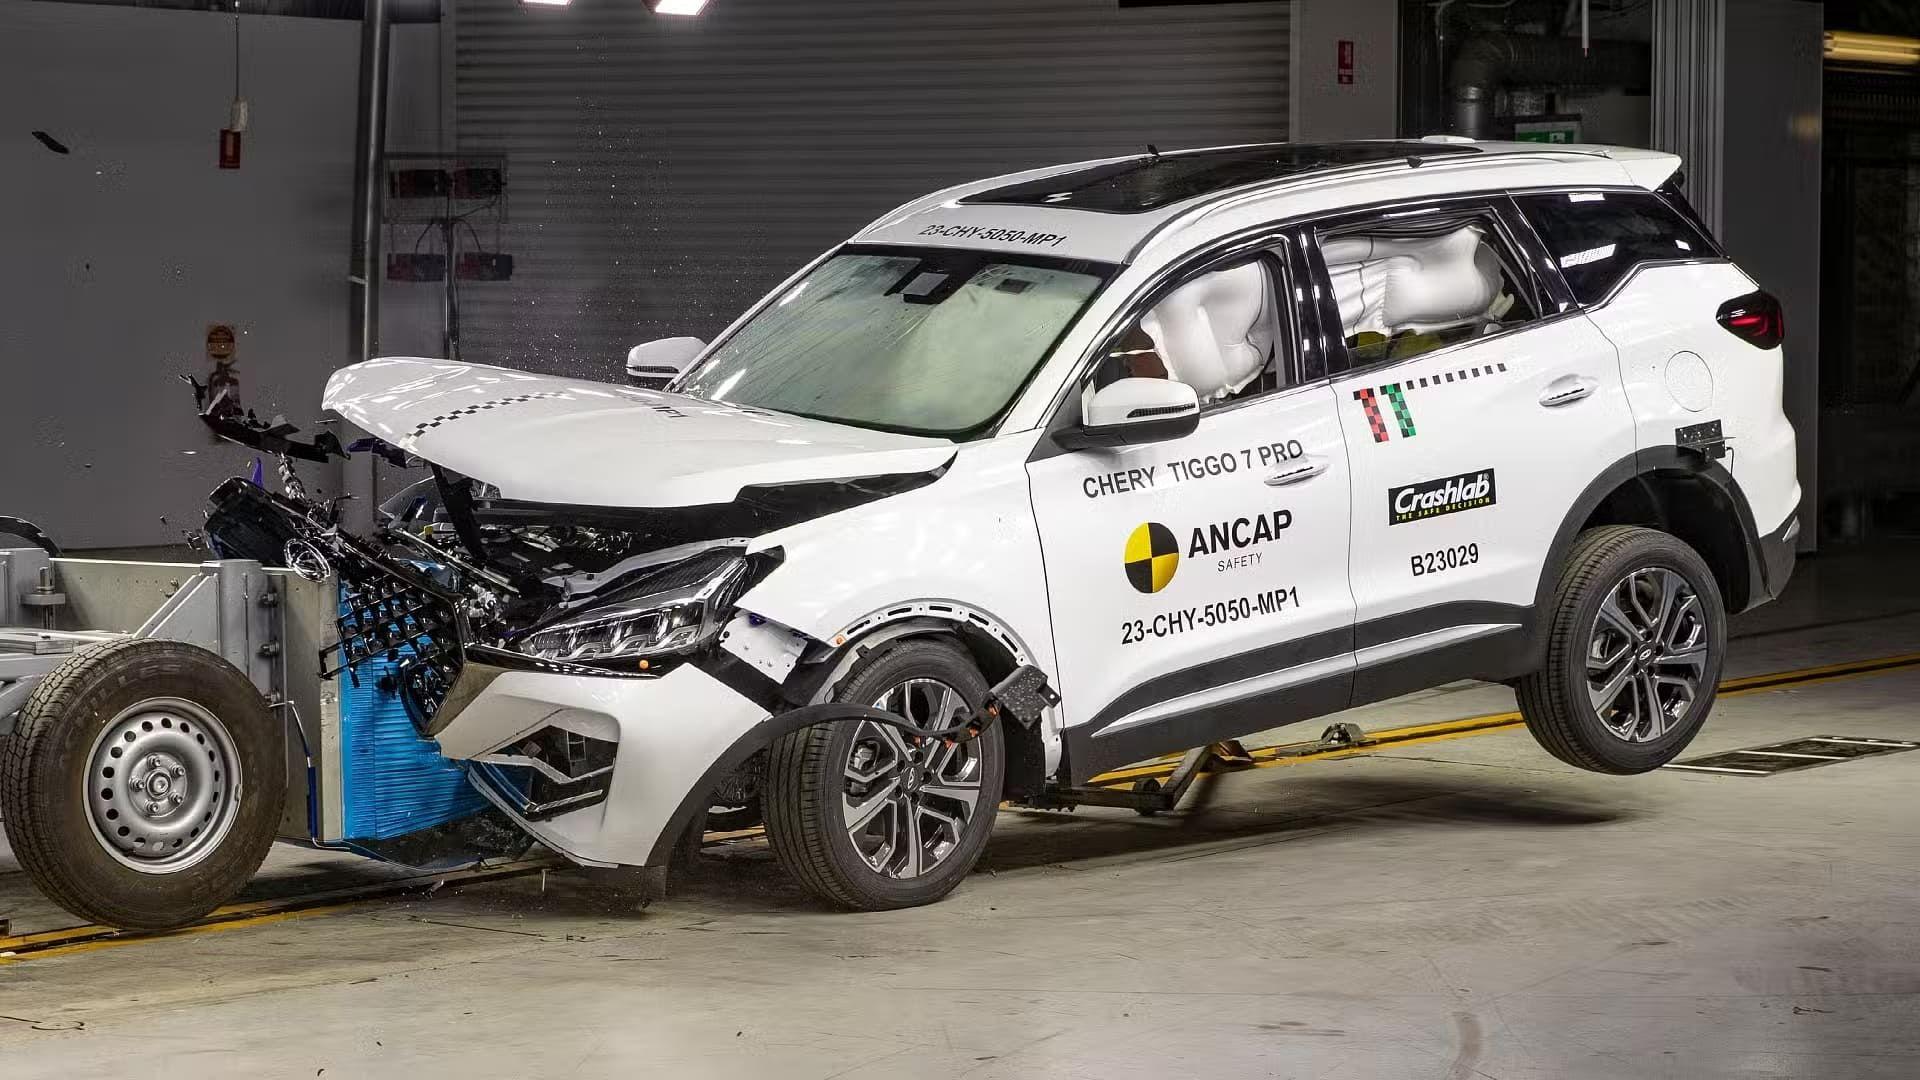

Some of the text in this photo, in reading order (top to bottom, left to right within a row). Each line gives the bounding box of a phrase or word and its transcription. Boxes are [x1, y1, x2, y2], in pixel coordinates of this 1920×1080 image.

[918, 224, 1067, 247] 23-CHY-5050-MP1
[1082, 439, 1304, 499] CHERY TIGGO 7 PRO
[1396, 497, 1490, 521] THE SAFE DECISION
[1188, 509, 1293, 558] ANCAP
[1217, 552, 1263, 572] SAFETY
[1410, 543, 1479, 576] B23029
[1121, 586, 1300, 645] 23-CHY-5050-MP1
